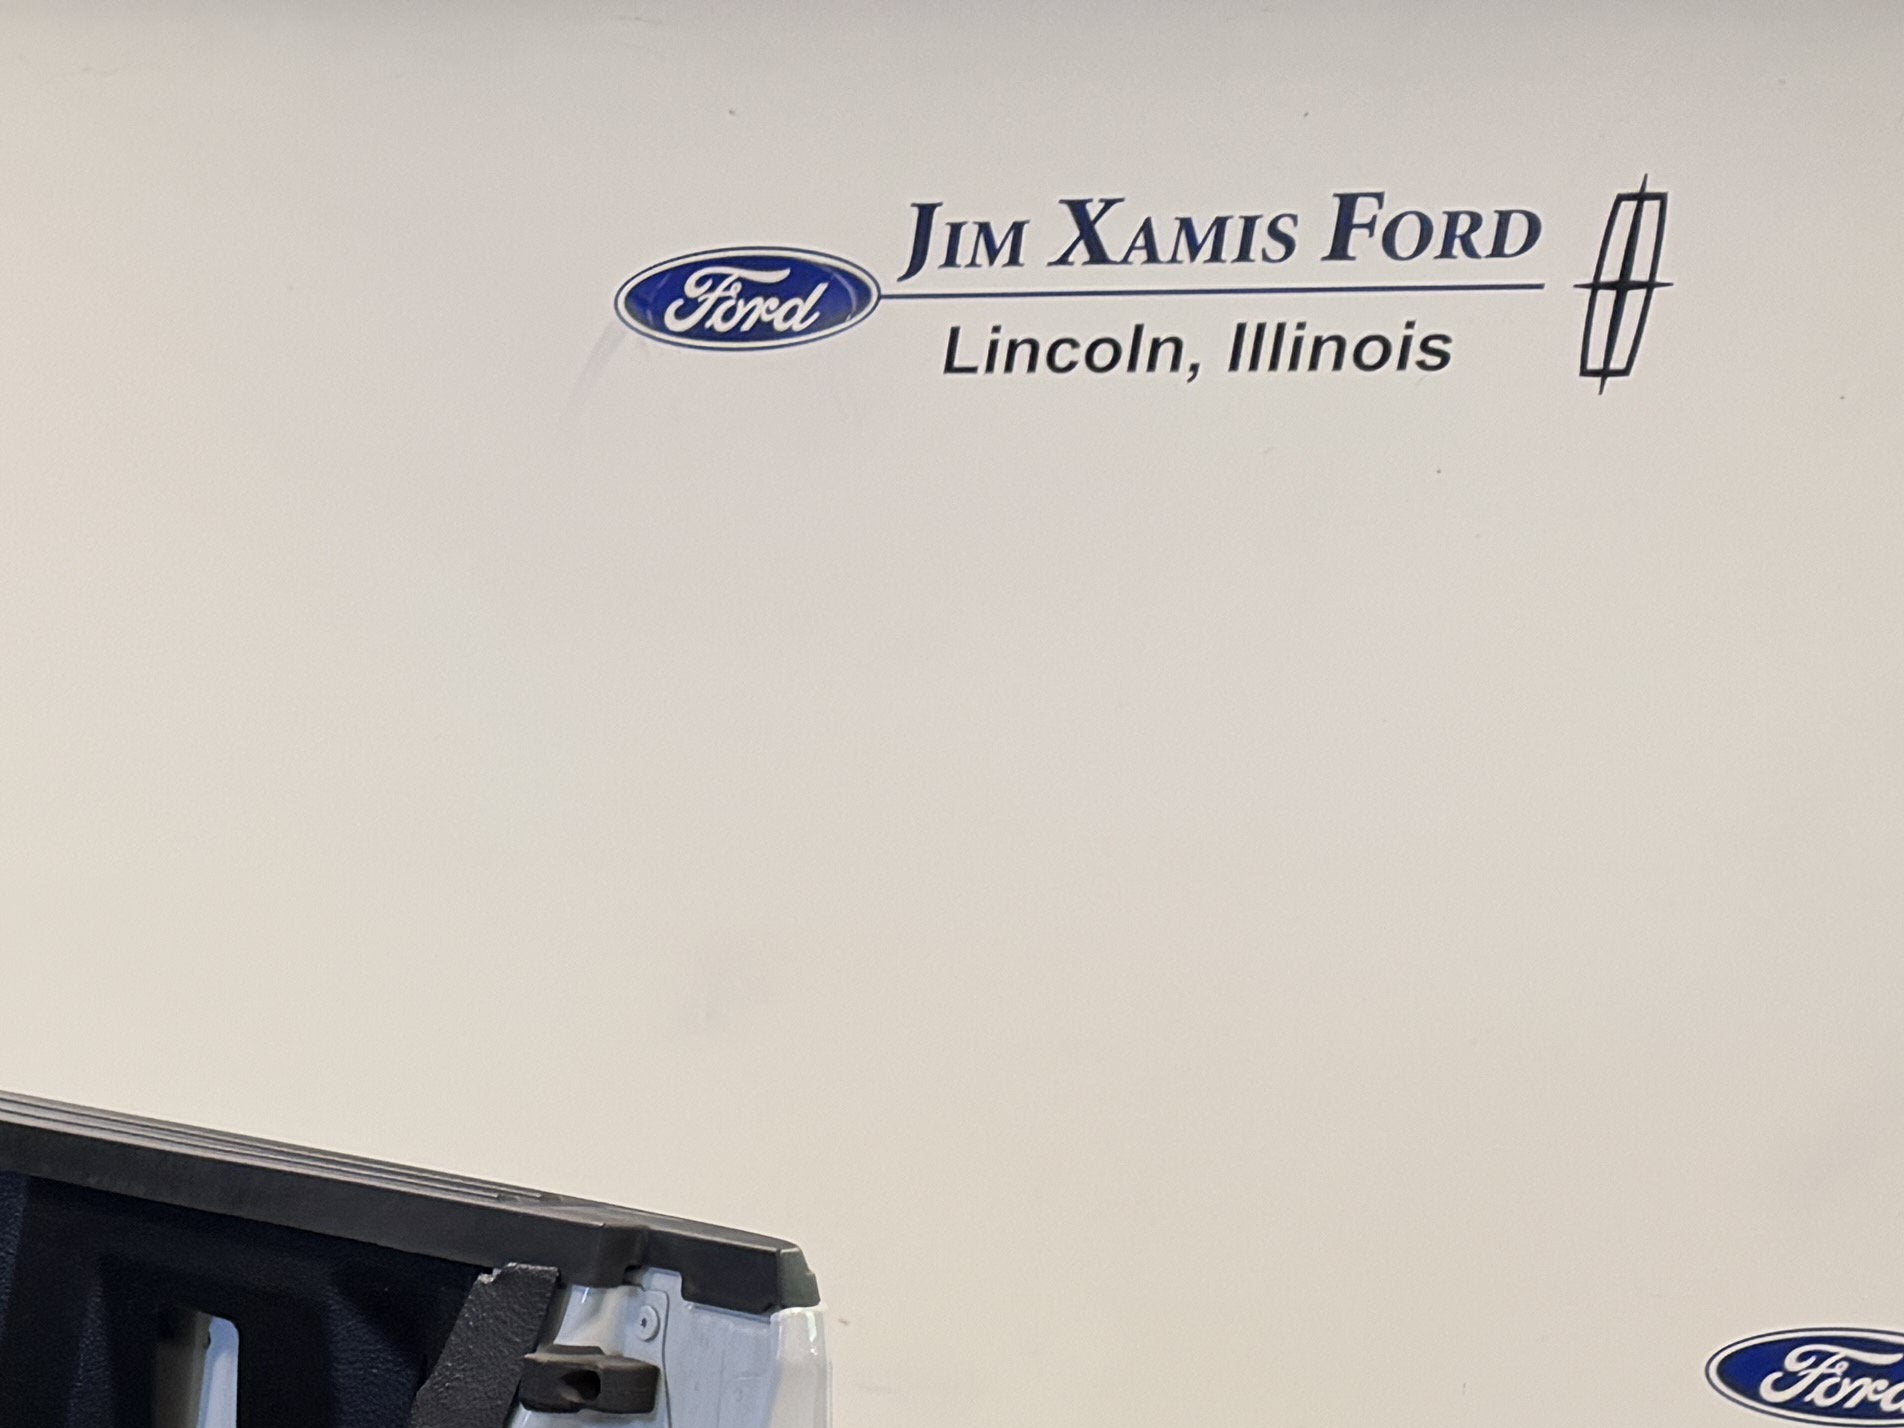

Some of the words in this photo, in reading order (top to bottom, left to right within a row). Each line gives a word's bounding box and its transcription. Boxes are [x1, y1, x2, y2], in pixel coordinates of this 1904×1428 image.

[896, 201, 1030, 283] JIM
[1046, 197, 1298, 267] XAMIS
[1320, 191, 1542, 262] FORD
[664, 265, 829, 333] Ford
[943, 322, 1201, 383] Lincoln,
[1228, 320, 1452, 372] Illinois
